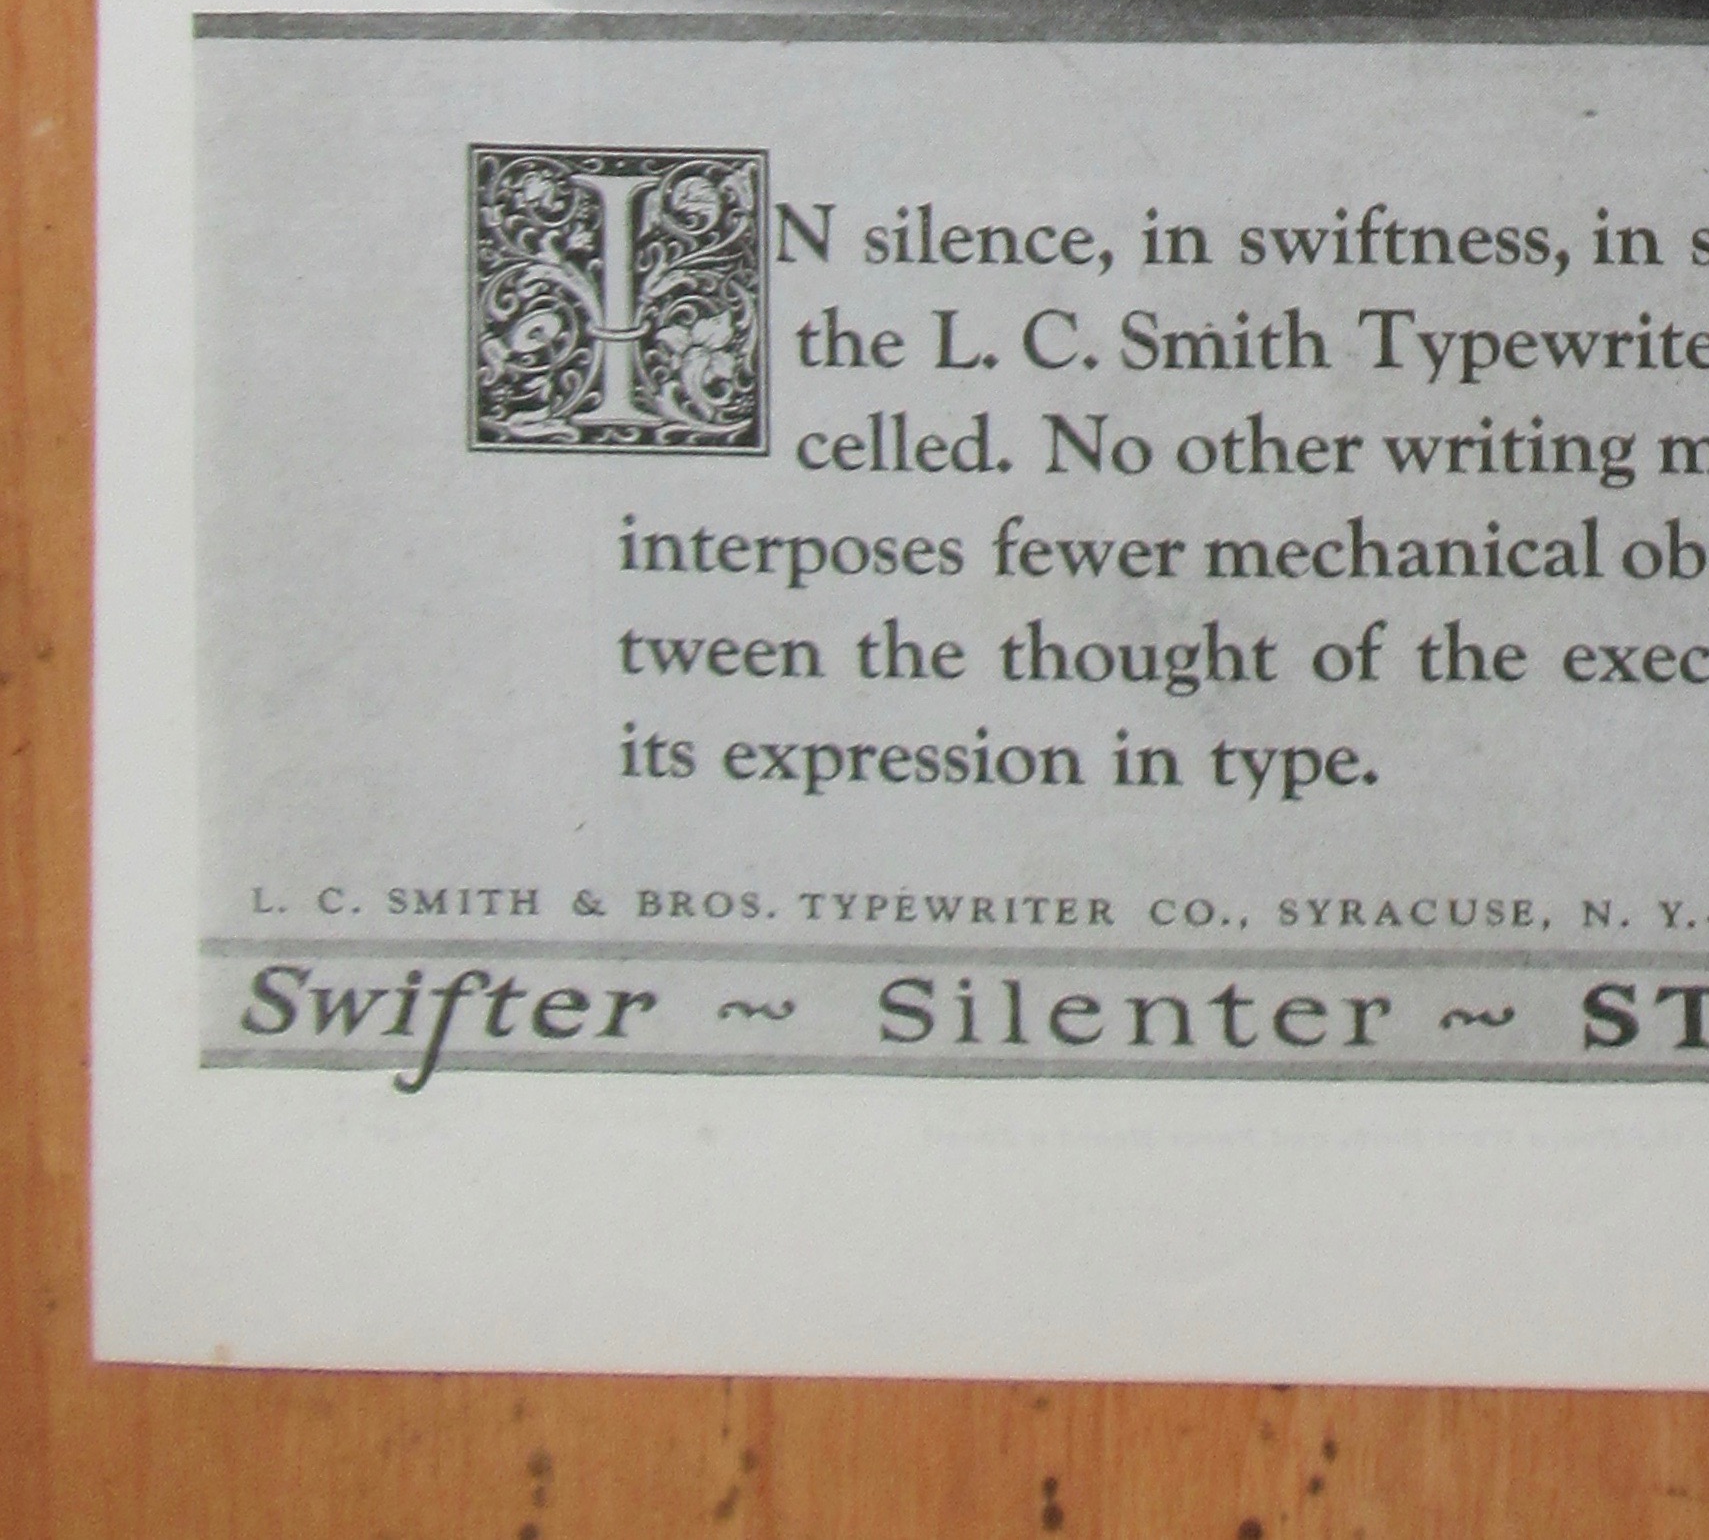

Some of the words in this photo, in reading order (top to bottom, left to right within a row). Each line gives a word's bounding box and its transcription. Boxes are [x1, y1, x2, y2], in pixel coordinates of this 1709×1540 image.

[864, 203, 1114, 275] silence,
[1142, 207, 1213, 265] in
[1240, 203, 1570, 277] swiftness,
[1593, 207, 1664, 265] in
[795, 306, 904, 369] the
[932, 310, 999, 370] L.
[1022, 308, 1099, 370] C.
[1122, 307, 1332, 371] Smith
[796, 411, 1013, 473] celled.
[1042, 414, 1153, 475] No
[1176, 412, 1364, 475] other
[1383, 415, 1636, 490] writing
[619, 514, 964, 590] interposes
[992, 515, 1186, 579] fewer
[1204, 515, 1604, 579] mechanical
[618, 630, 825, 678] tween
[856, 617, 965, 680] the
[1000, 619, 1277, 698] thought
[1312, 619, 1388, 683] of
[1417, 619, 1527, 683] the
[621, 721, 696, 779] its
[723, 726, 1085, 796] expression
[1114, 729, 1181, 786] in
[1211, 740, 1378, 801] type.
[252, 886, 288, 914] L.
[317, 886, 361, 915] C.
[388, 887, 539, 916] SMITH
[572, 889, 606, 917] &
[637, 889, 776, 919] BROS.
[799, 892, 1115, 926] TYPEWRITER
[1148, 898, 1248, 930] CO.,
[1279, 898, 1551, 932] SYRACUSE,
[1582, 900, 1630, 928] N.
[240, 965, 664, 1094] Swifter
[879, 977, 1392, 1049] Silenter
